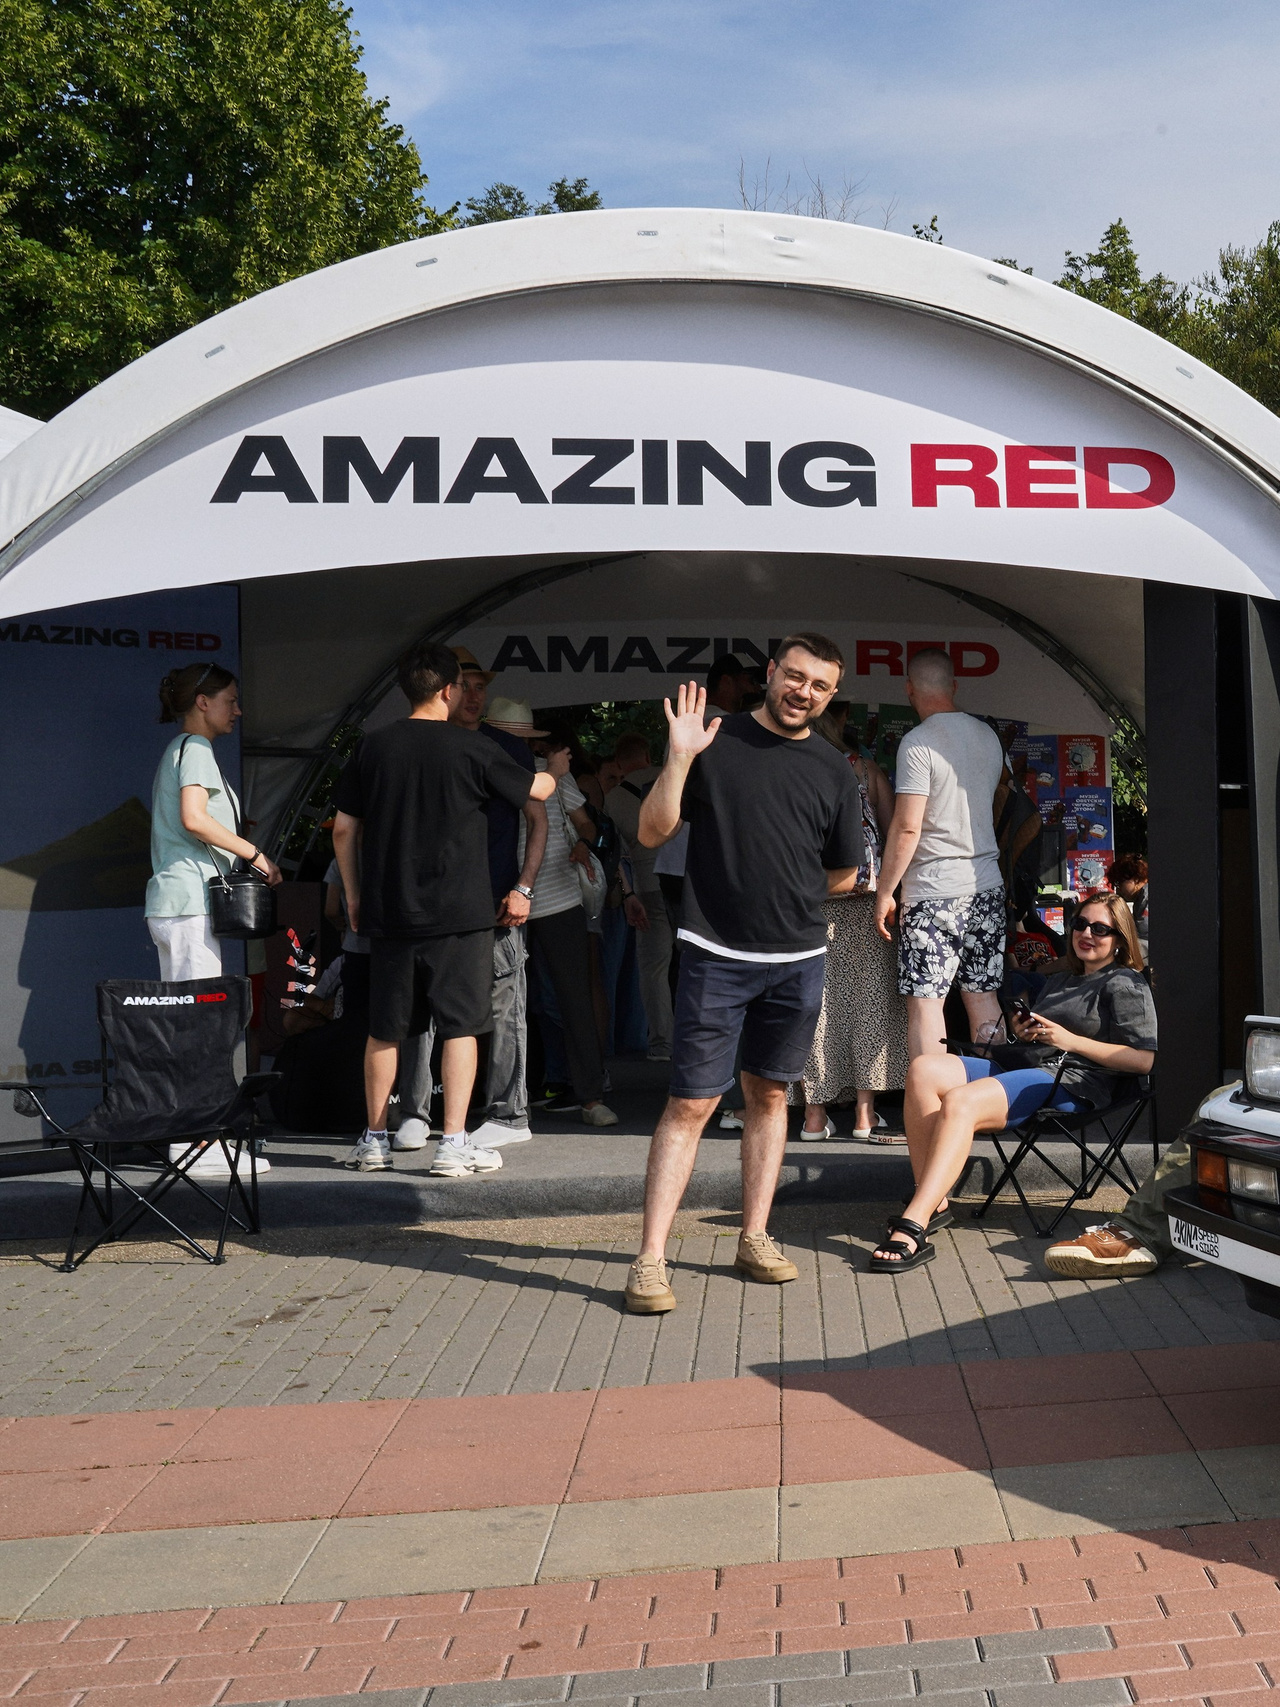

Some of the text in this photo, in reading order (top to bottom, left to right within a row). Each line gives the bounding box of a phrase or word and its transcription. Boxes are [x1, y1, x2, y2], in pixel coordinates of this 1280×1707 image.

[210, 435, 1176, 509] AMAZING RED
[147, 630, 222, 651] RED
[490, 635, 783, 675] AMAZIN
[123, 992, 227, 1006] AMAZING RED
[1173, 1218, 1219, 1251] AKINA SPEED
